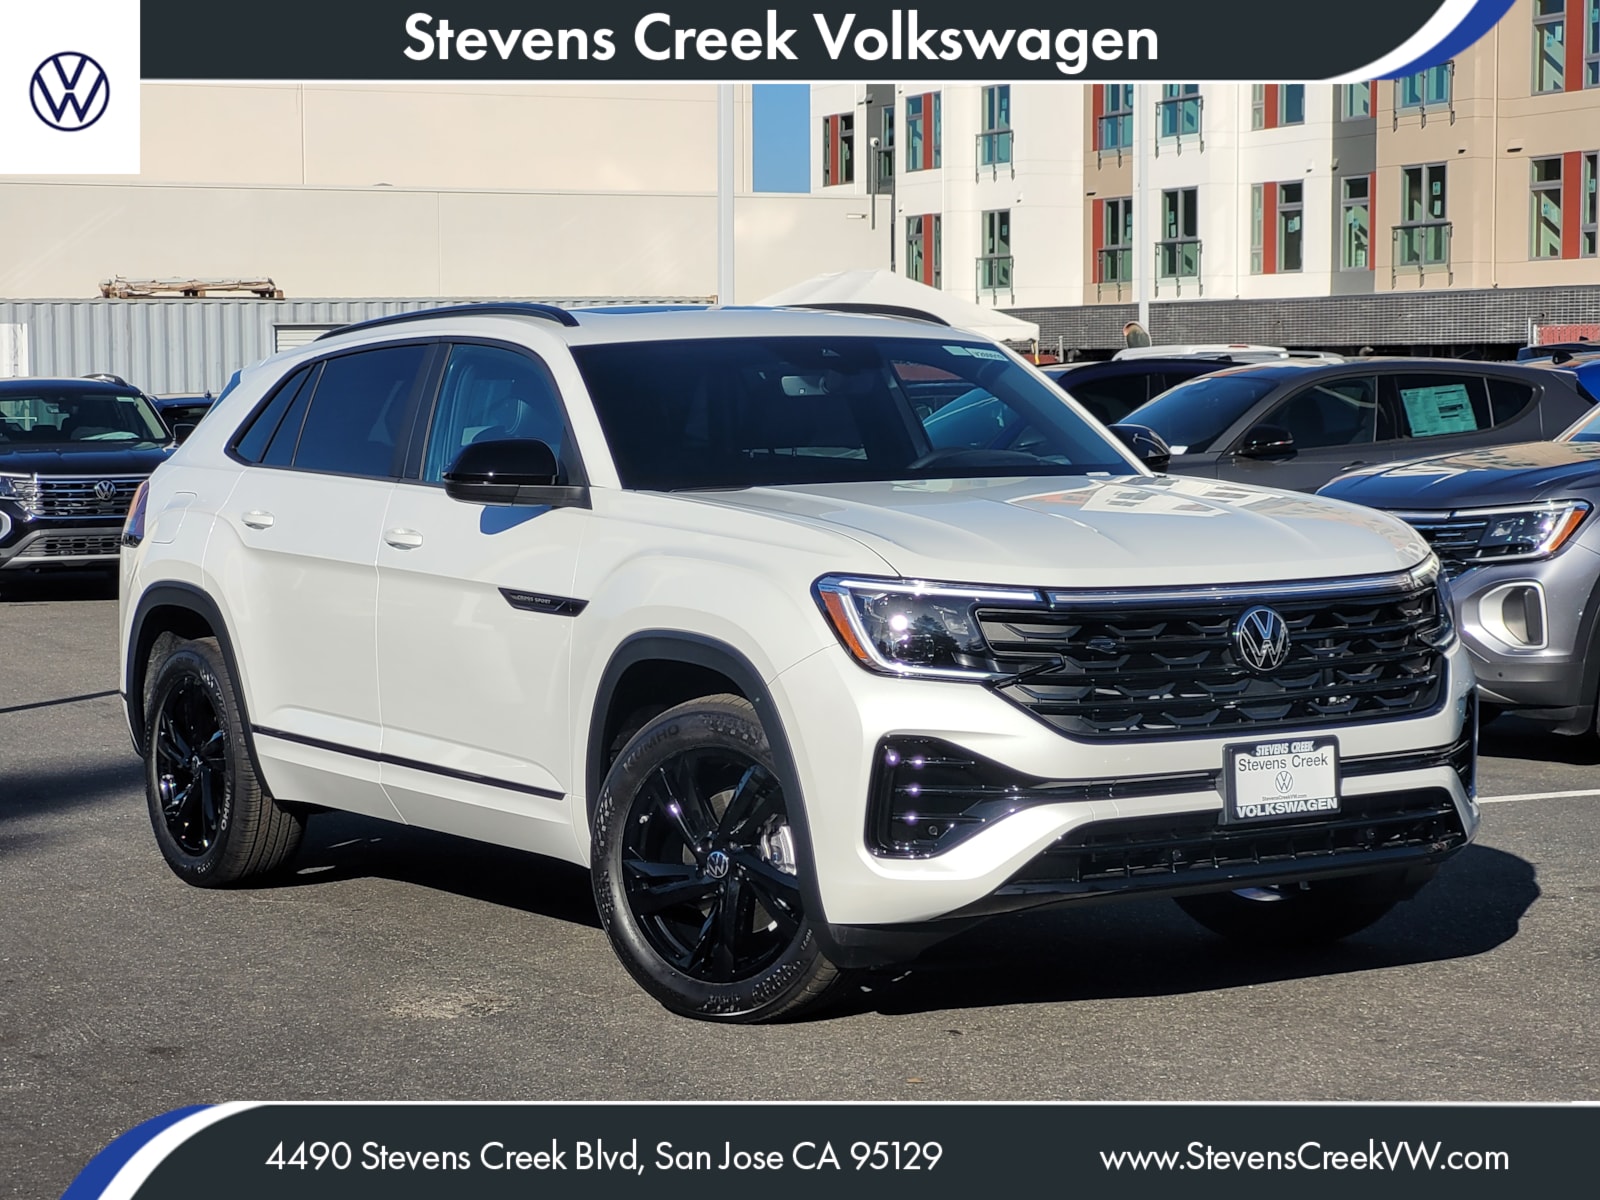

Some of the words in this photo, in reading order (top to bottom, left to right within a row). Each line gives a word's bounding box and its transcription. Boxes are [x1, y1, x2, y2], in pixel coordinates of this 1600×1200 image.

[623, 724, 679, 774] KUMHO
[1255, 742, 1290, 757] STEVENS
[1291, 741, 1314, 753] CREEK
[1238, 757, 1287, 772] Stevens
[1291, 753, 1329, 768] Creek
[1236, 798, 1338, 818] VOLKSWAGEN
